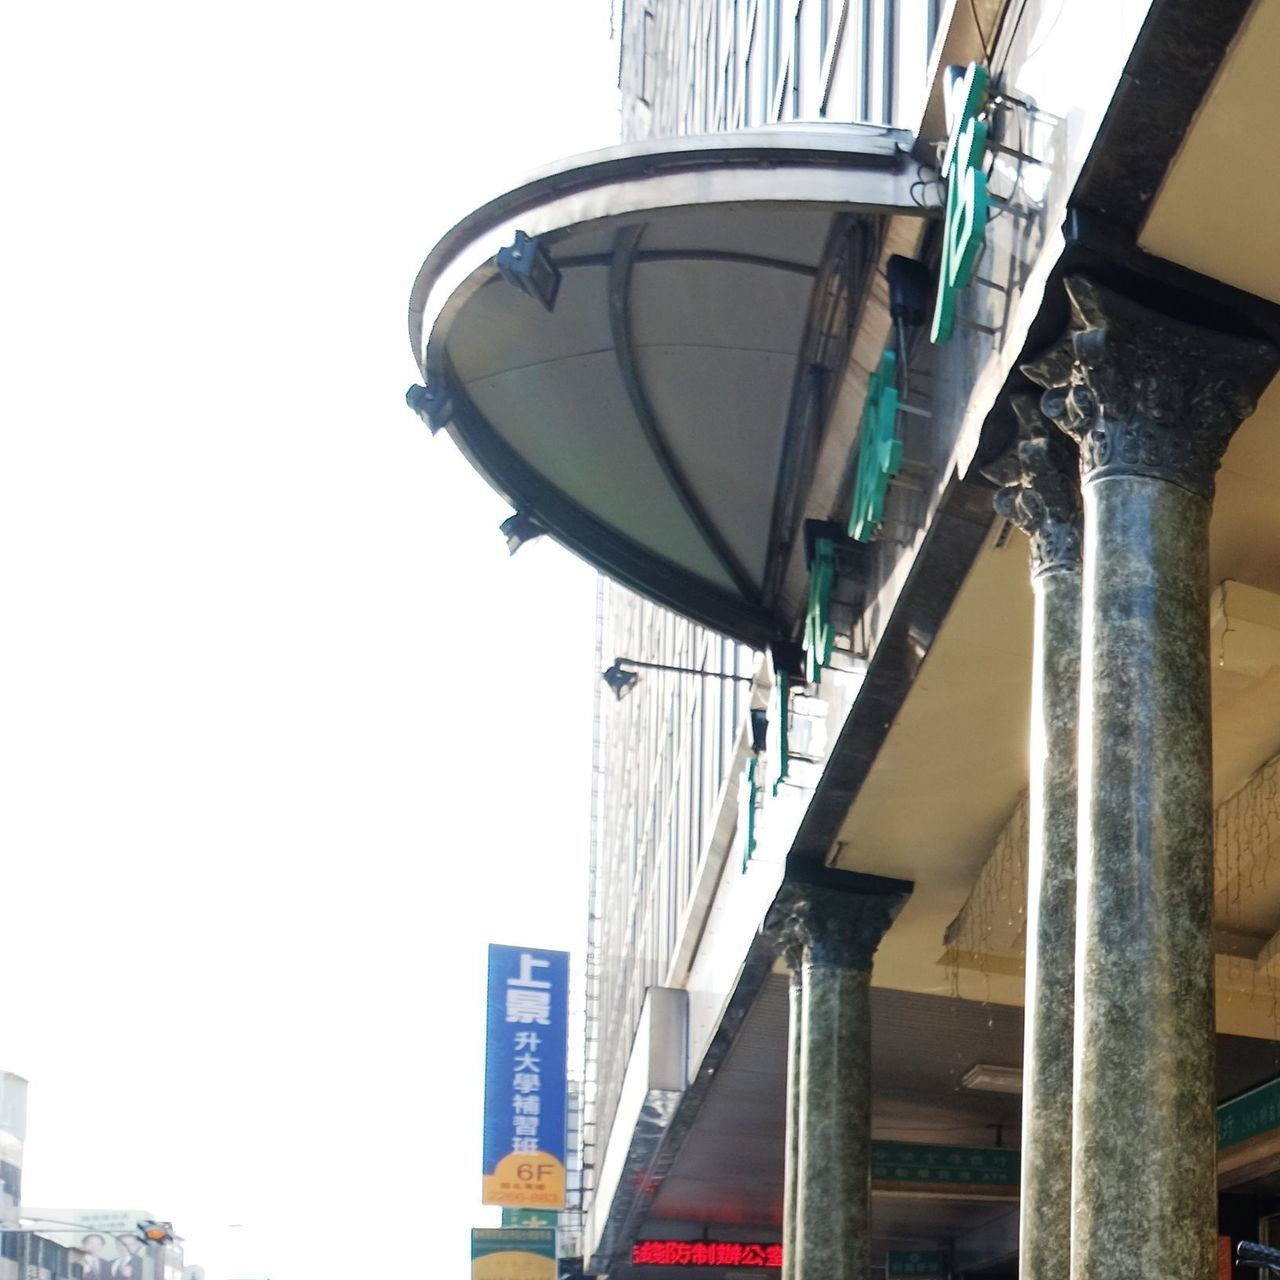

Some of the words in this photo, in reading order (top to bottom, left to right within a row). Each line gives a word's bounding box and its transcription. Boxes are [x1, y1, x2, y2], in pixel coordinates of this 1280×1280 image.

[505, 953, 551, 1025] 上景
[512, 1032, 541, 1155] 升大學補習班
[516, 1163, 555, 1182] 6F
